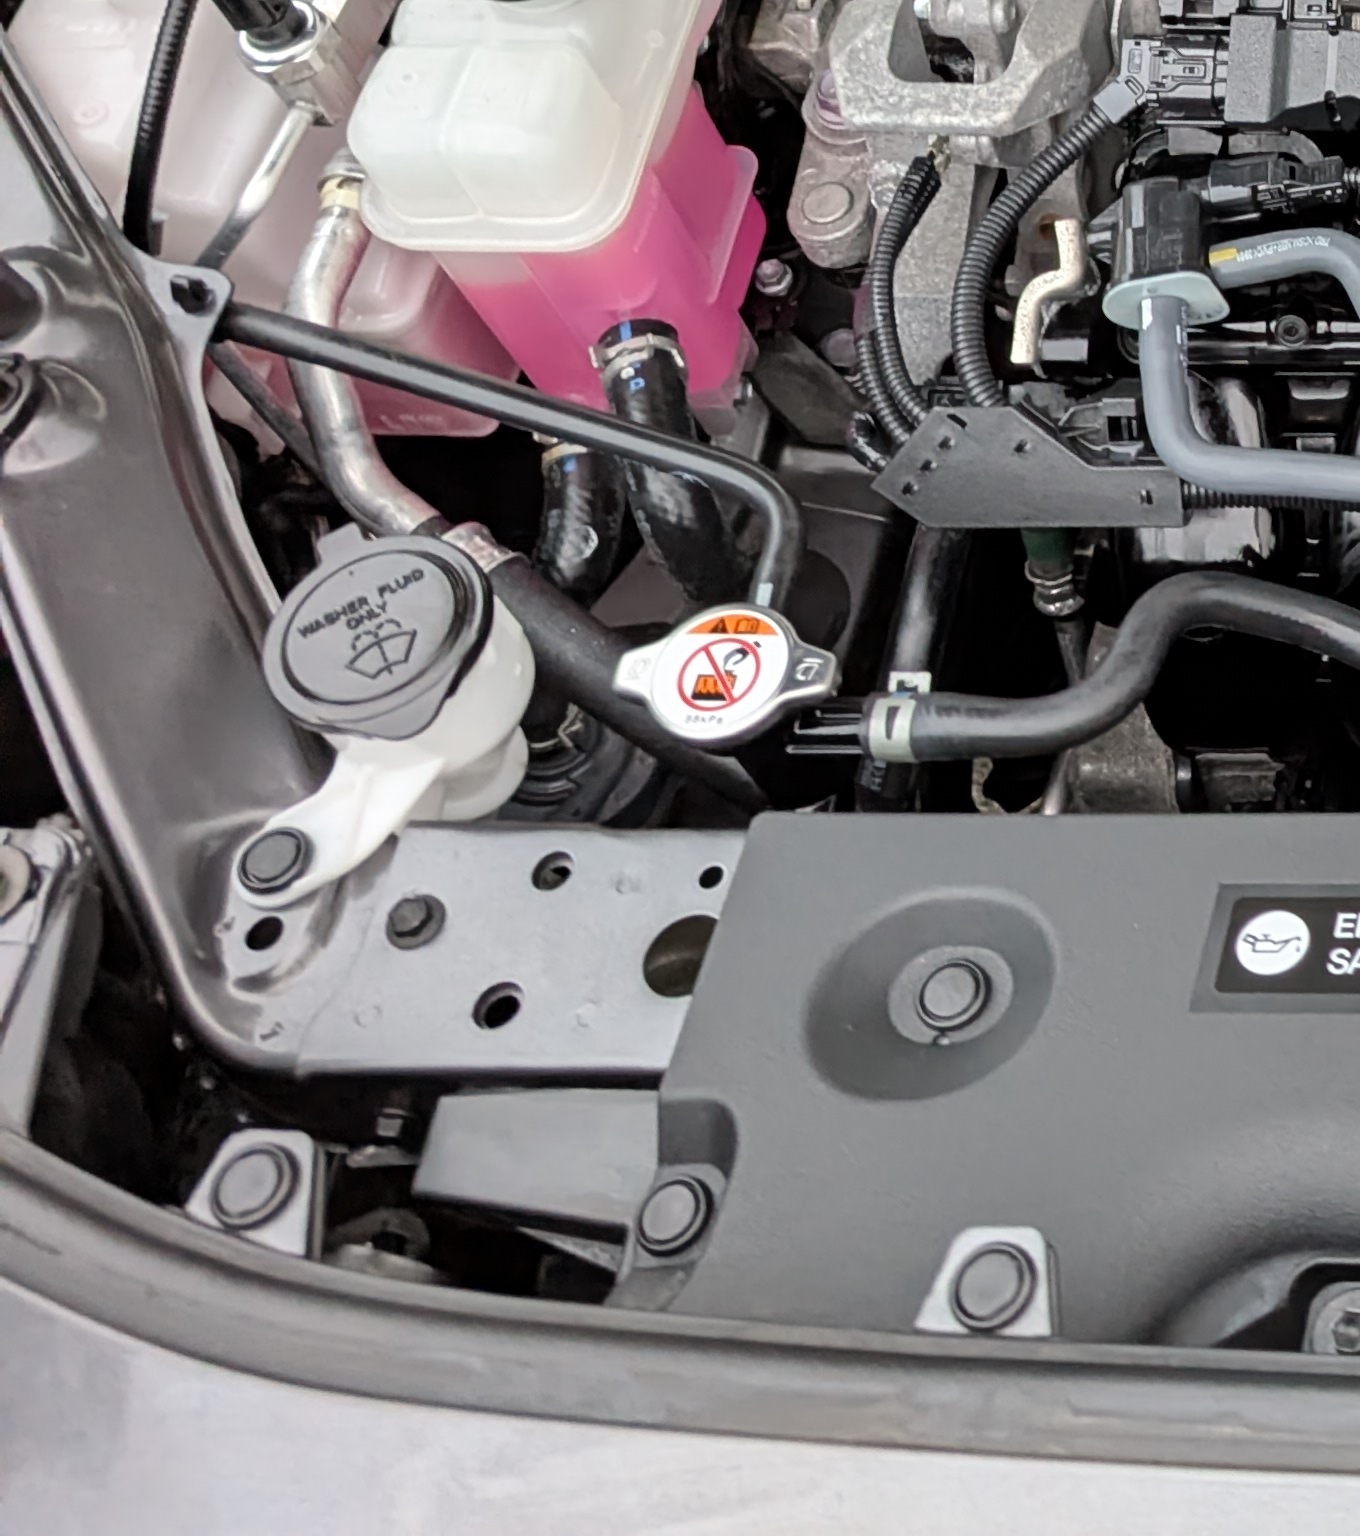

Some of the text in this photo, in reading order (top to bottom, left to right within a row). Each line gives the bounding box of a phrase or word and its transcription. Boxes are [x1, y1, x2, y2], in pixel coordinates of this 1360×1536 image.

[296, 567, 425, 639] WASHER FLUID
[345, 598, 388, 631] ONLY
[684, 715, 724, 725] 88kPa
